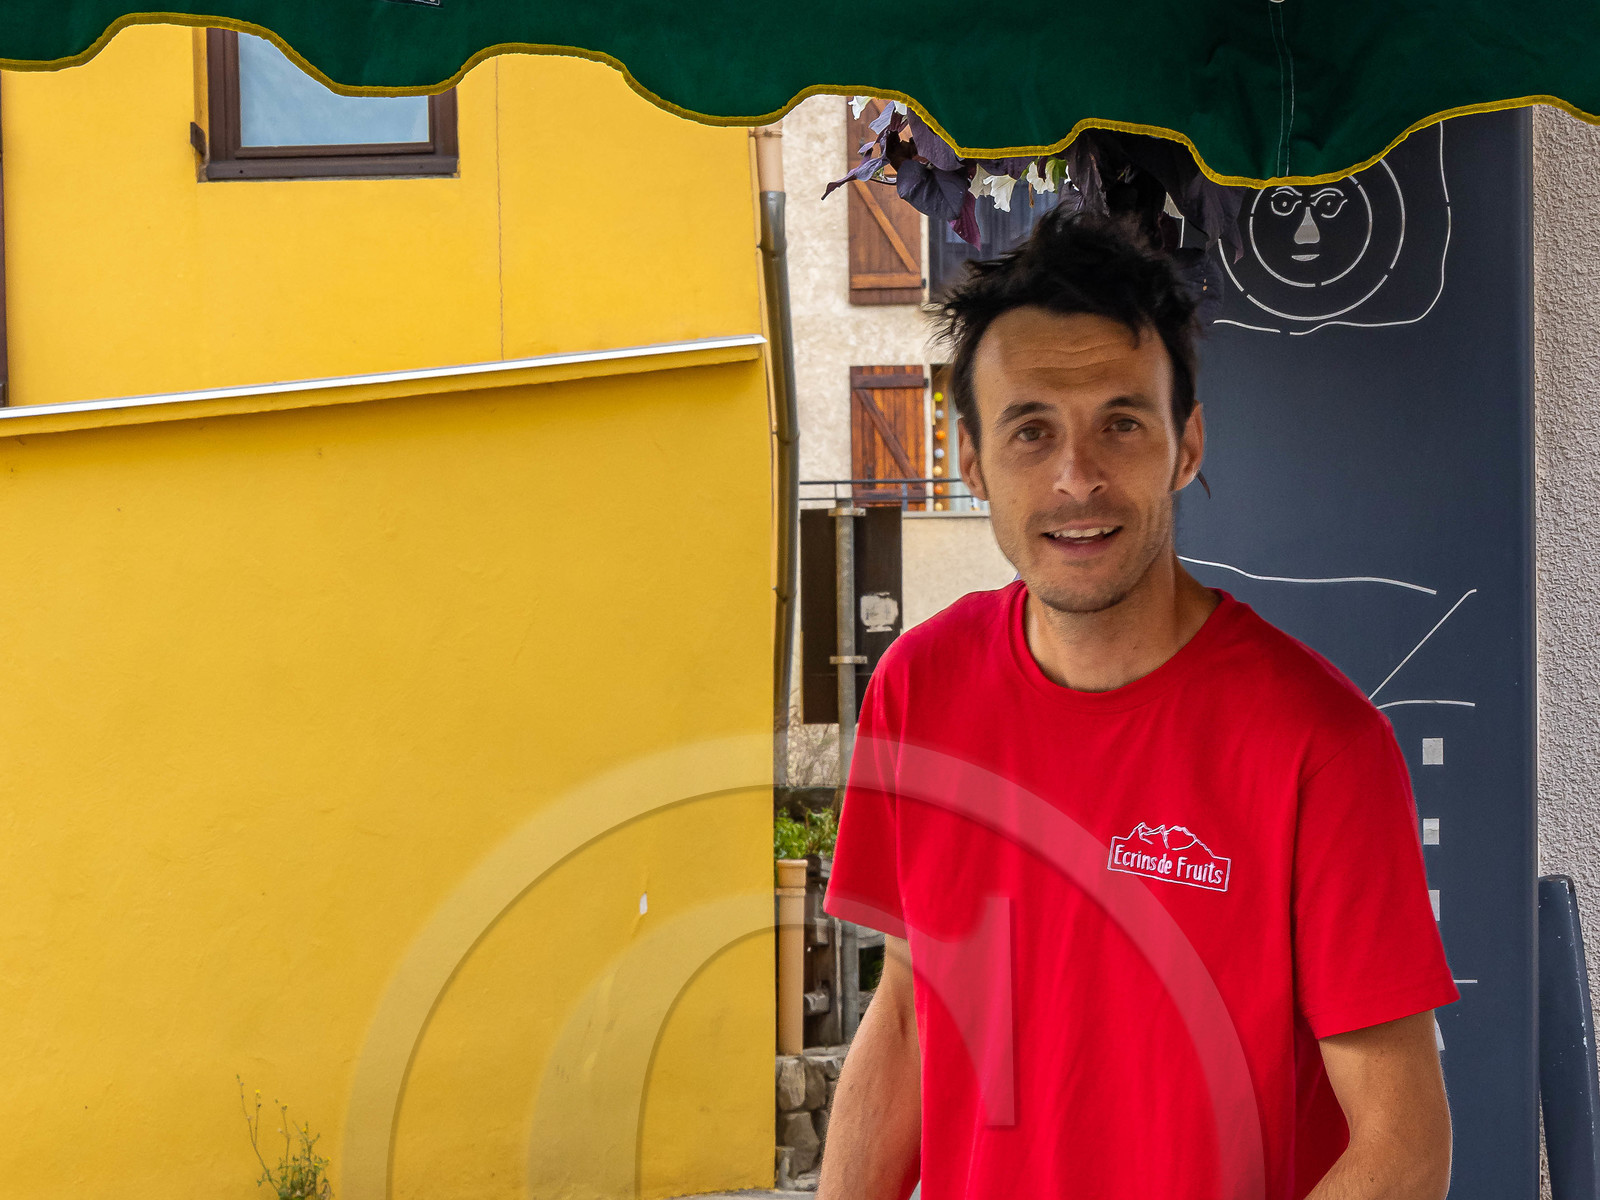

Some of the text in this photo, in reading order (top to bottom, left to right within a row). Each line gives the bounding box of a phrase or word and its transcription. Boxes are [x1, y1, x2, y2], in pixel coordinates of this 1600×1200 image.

[1113, 844, 1224, 884] Ecrins de Fruits
